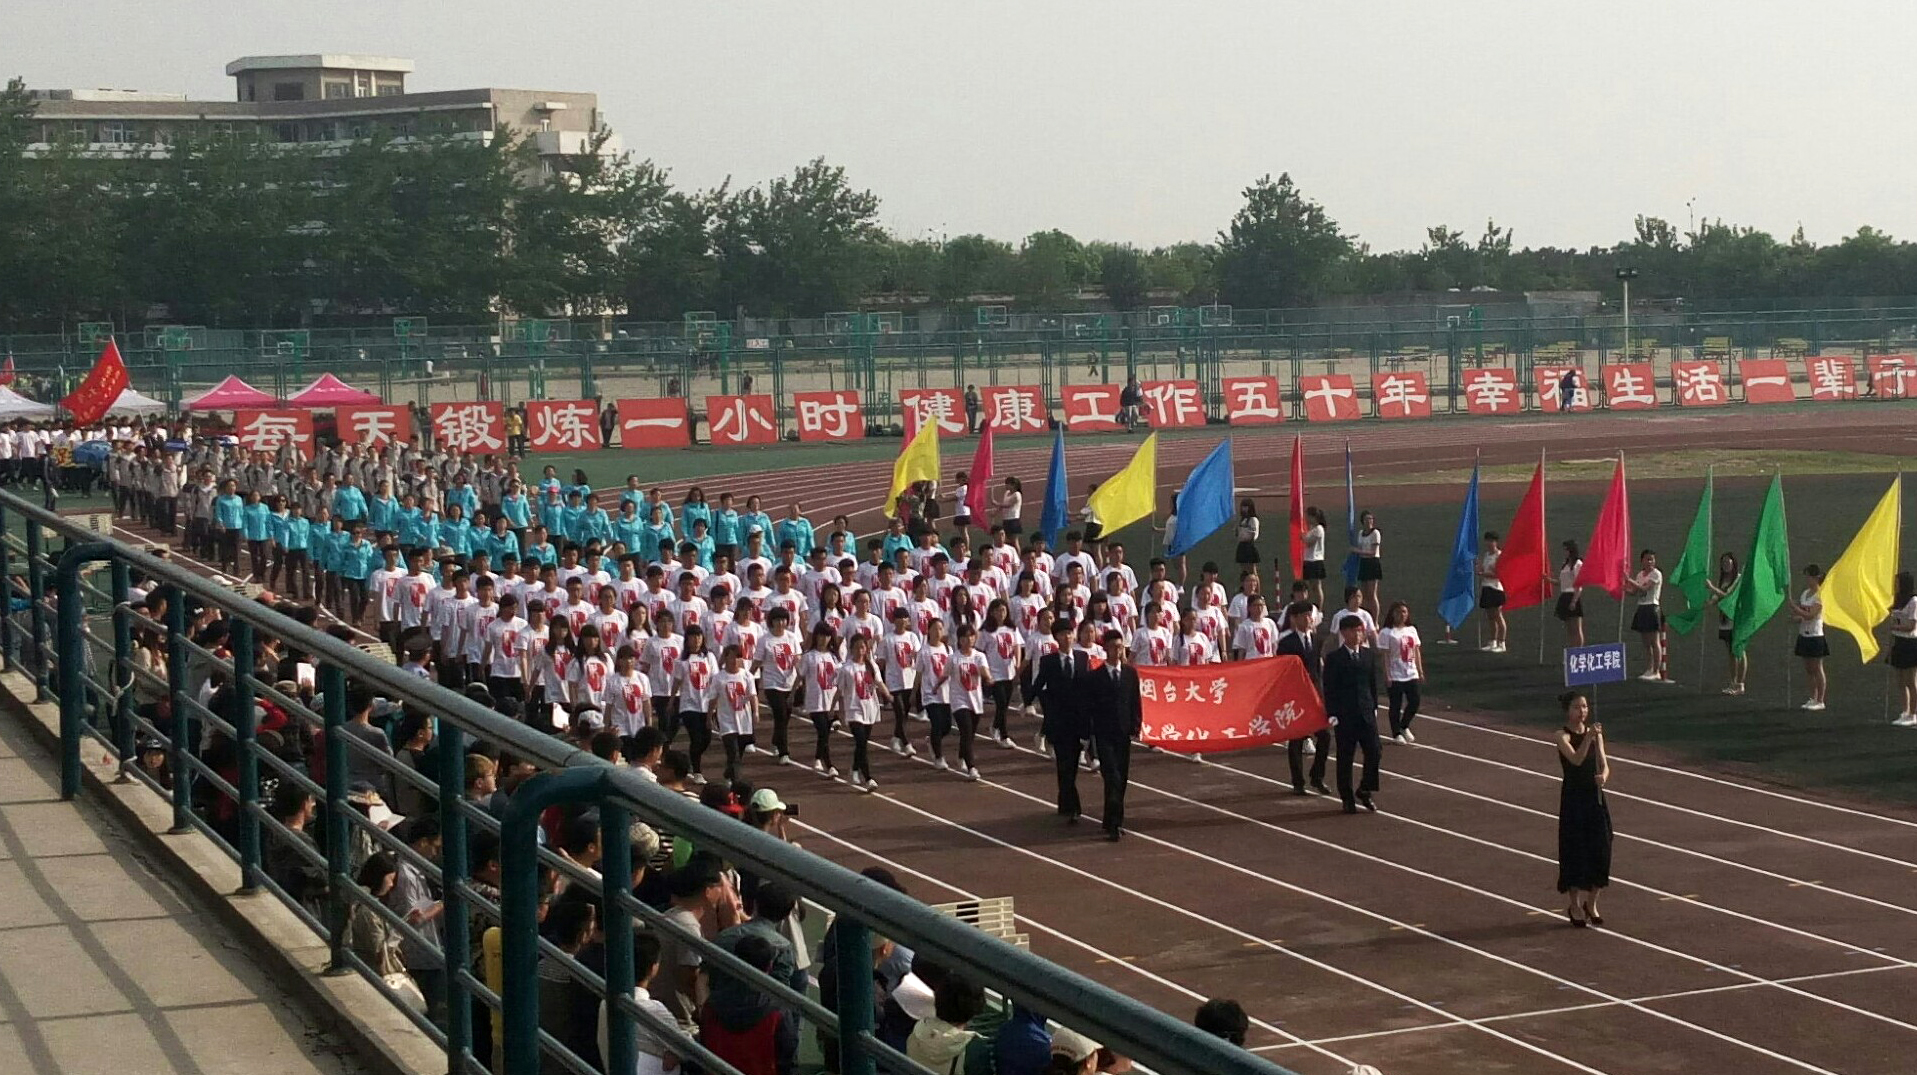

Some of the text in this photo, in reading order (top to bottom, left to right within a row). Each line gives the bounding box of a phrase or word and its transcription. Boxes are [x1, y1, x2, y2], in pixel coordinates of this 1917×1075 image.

[1570, 651, 1621, 673] 化学化工学院
